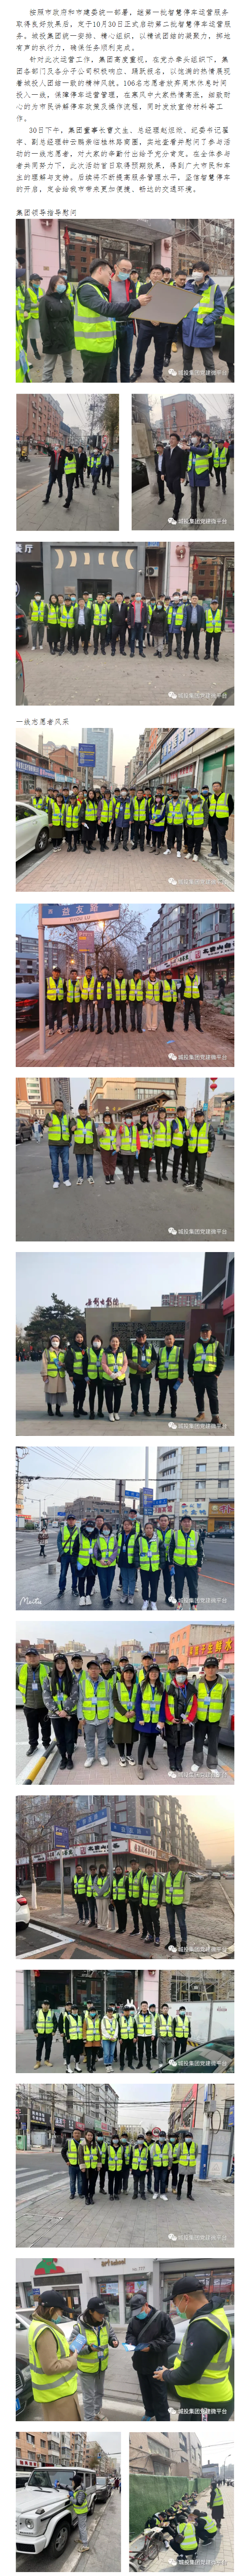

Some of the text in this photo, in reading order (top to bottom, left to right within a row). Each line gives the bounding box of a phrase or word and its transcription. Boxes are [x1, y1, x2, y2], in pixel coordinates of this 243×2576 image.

[62, 904, 98, 916] 益友路
[83, 1814, 98, 1825] 陕西路
